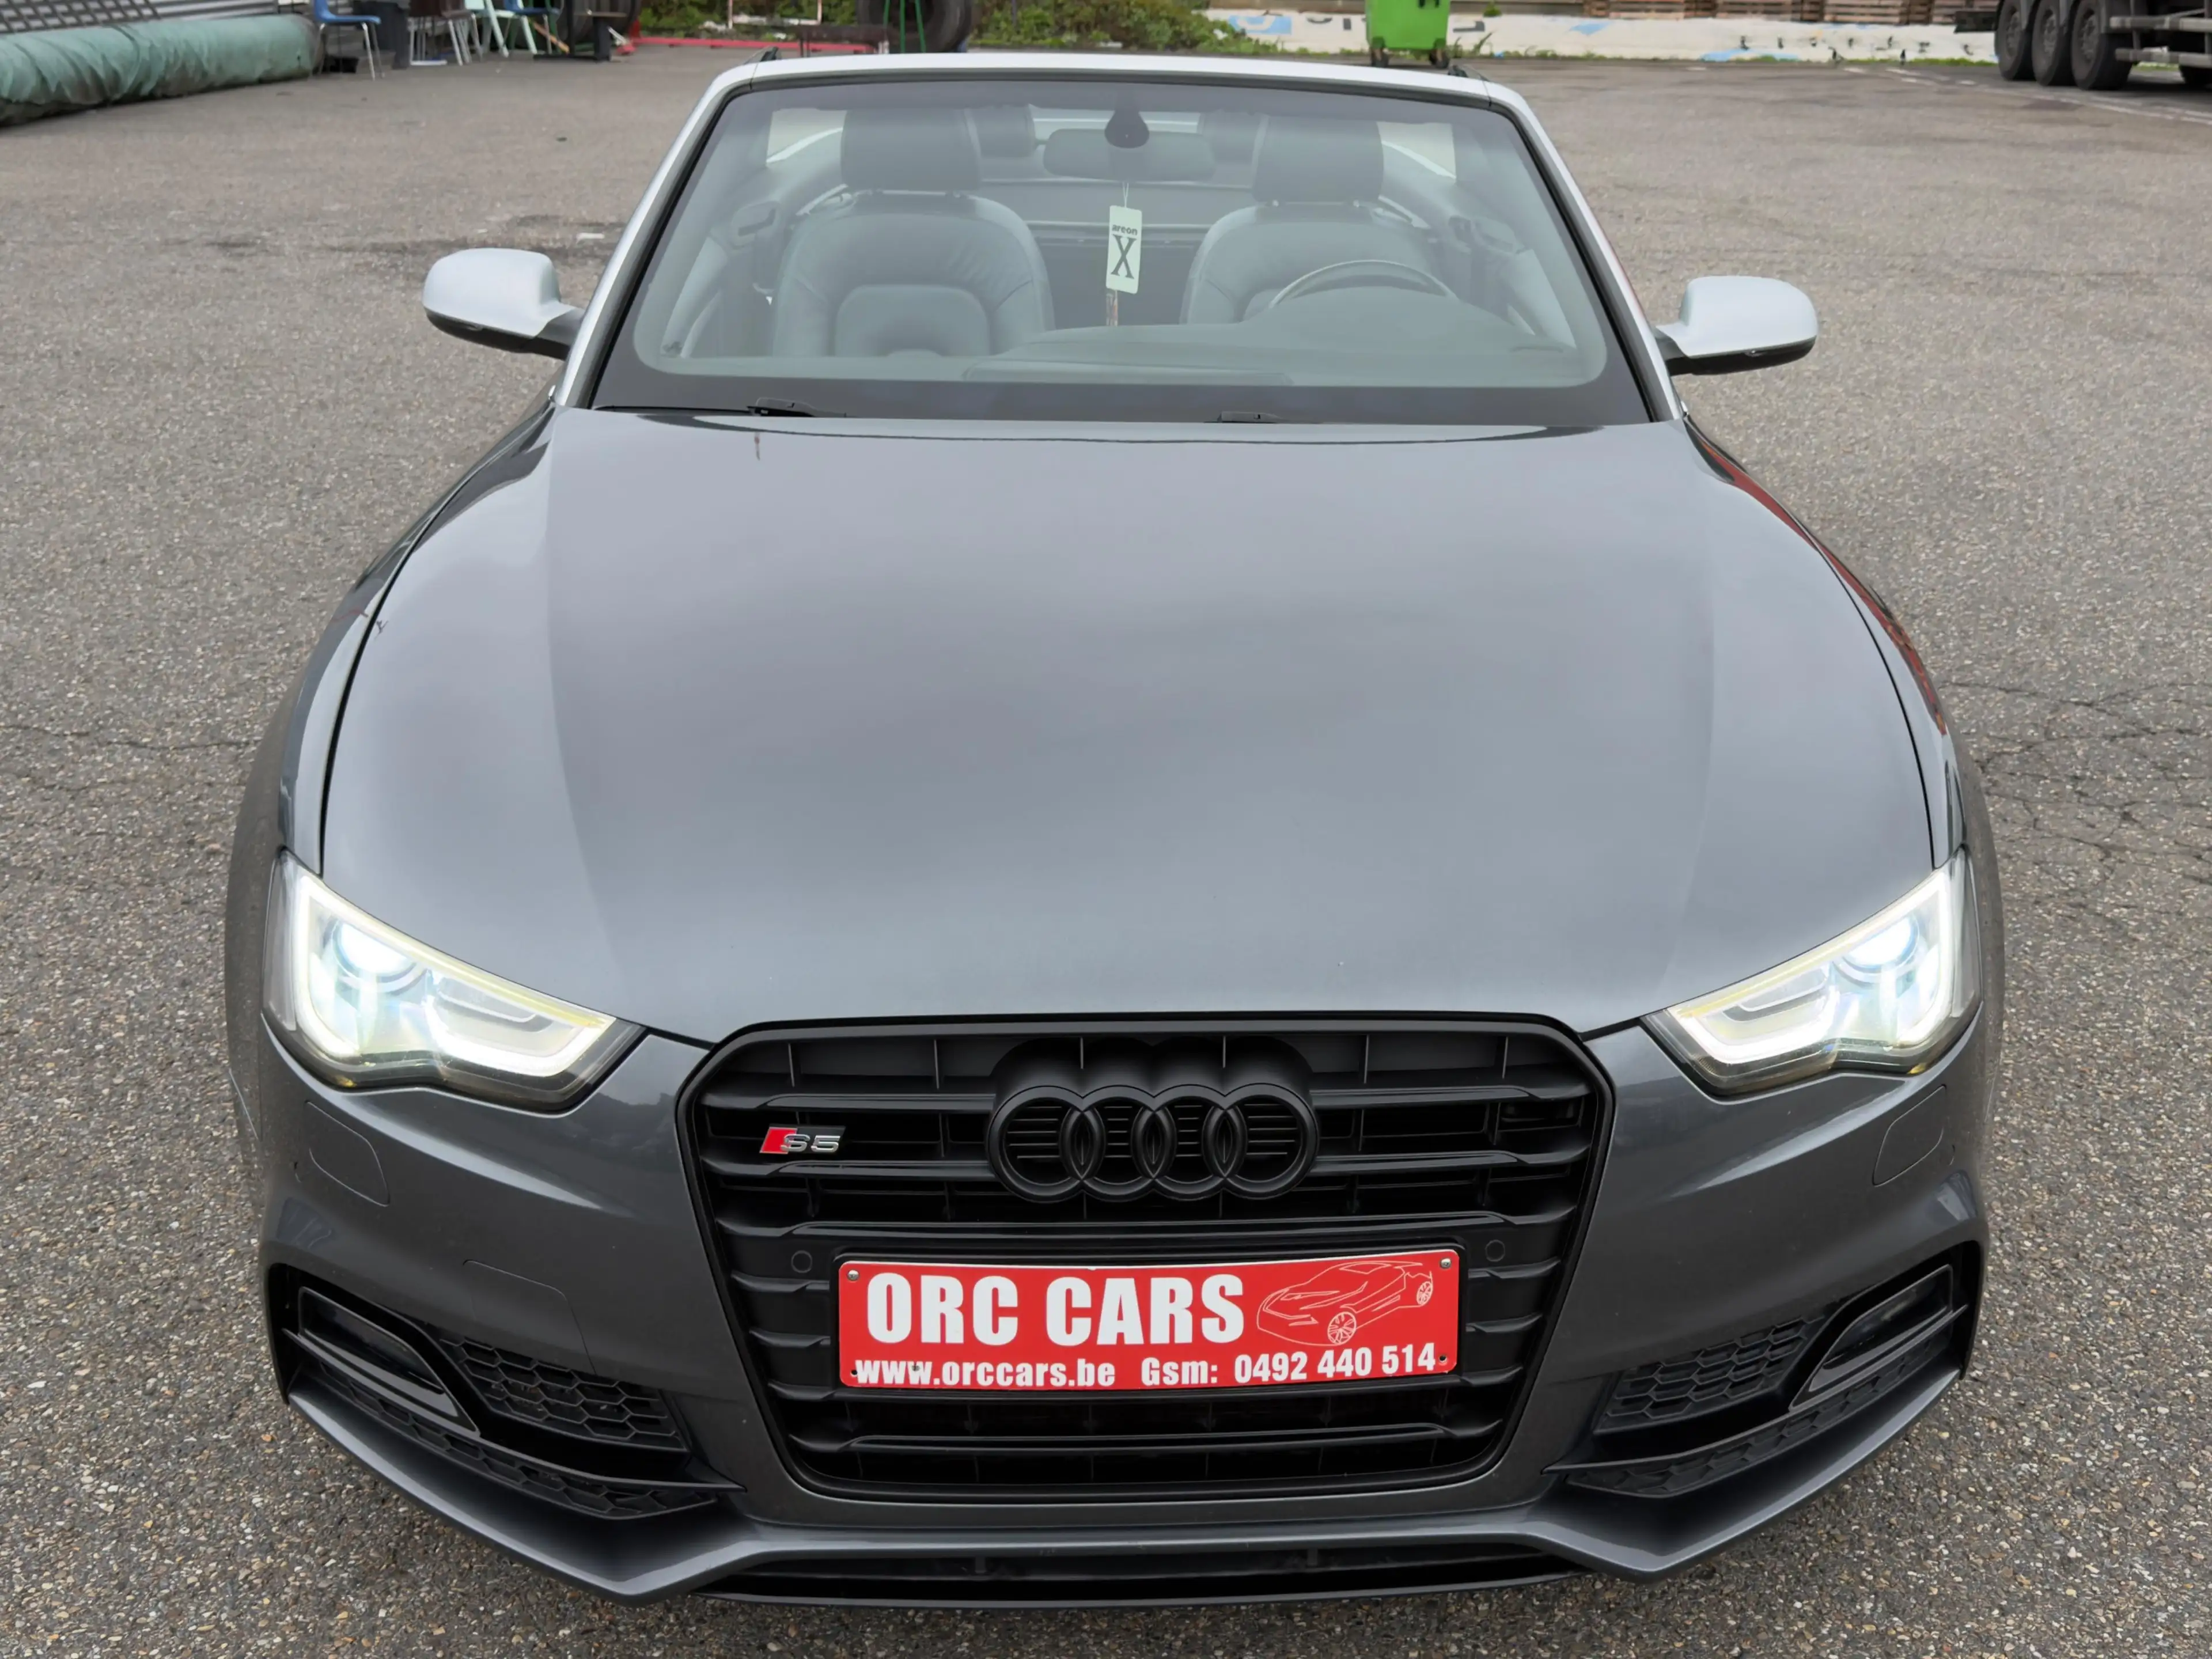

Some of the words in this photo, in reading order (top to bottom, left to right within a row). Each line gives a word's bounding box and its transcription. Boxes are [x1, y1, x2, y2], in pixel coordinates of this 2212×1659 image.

[1112, 224, 1138, 236] areon
[1111, 234, 1137, 279] X
[781, 1134, 840, 1153] S5
[868, 1273, 1018, 1345] ORC
[1047, 1274, 1244, 1346] CARS
[855, 1359, 1115, 1387] www.orccars.be
[1142, 1355, 1217, 1385] Gsm:
[1235, 1351, 1307, 1383] 0492
[1317, 1347, 1372, 1377] 440
[1382, 1343, 1435, 1374] 514
